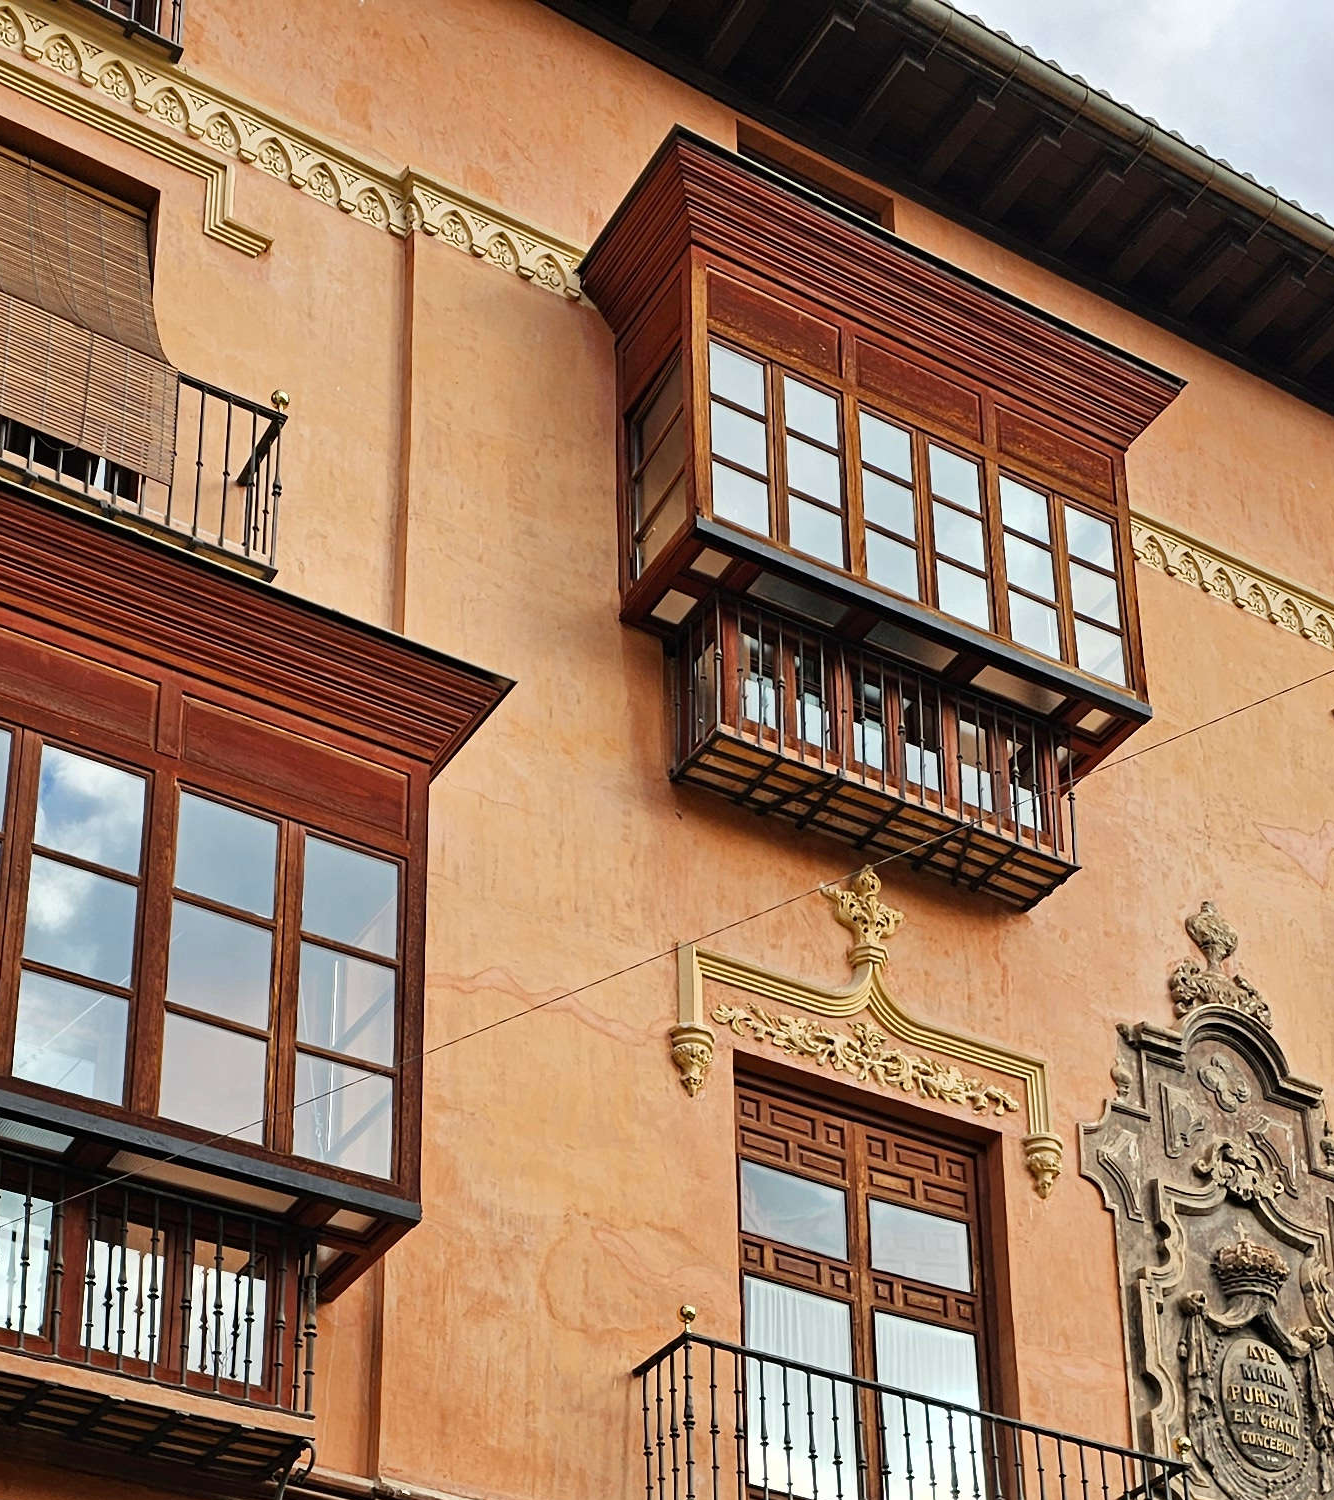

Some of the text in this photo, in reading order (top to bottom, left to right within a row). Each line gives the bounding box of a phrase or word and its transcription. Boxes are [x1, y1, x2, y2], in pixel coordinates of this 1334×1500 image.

[1247, 1343, 1276, 1366] AVE
[1239, 1363, 1288, 1391] MARIA
[1232, 1409, 1301, 1440] EN GRACIA
[1240, 1430, 1296, 1457] CONCEBIDA
